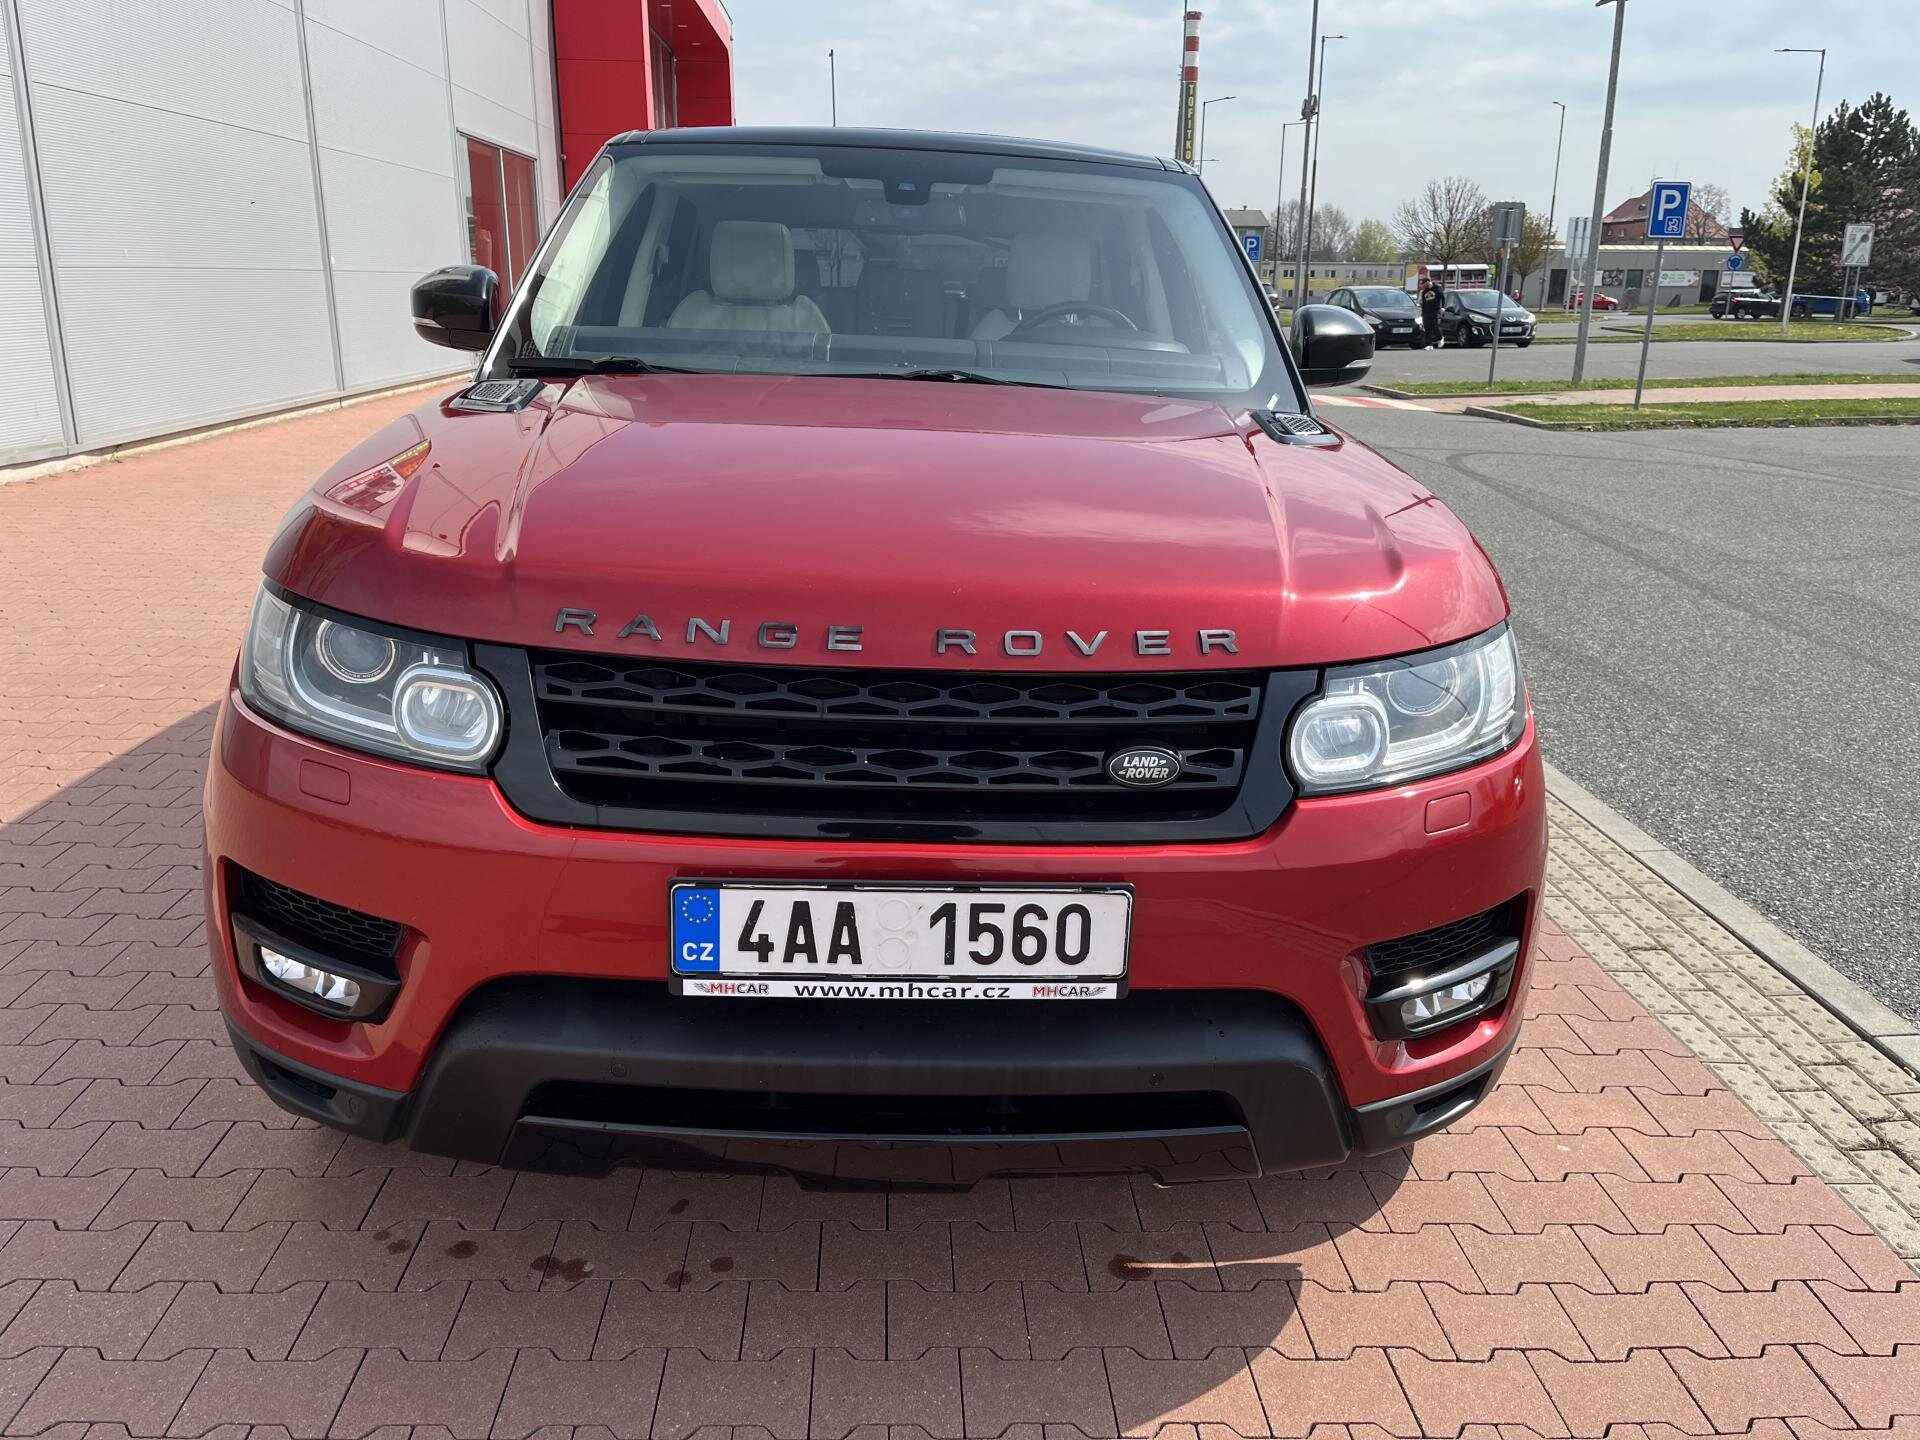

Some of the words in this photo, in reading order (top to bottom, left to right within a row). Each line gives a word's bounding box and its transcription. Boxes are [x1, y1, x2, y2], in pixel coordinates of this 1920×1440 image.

[1658, 190, 1681, 221] P
[1246, 238, 1257, 253] P
[554, 607, 865, 651] RANGE
[937, 628, 1240, 657] ROVER
[737, 899, 862, 965] 4AA
[929, 902, 1092, 966] 1560
[682, 942, 714, 962] CZ
[709, 982, 769, 995] MHCAR
[794, 982, 1010, 999] www.mhcar.cz
[1032, 984, 1090, 997] MHCAR
